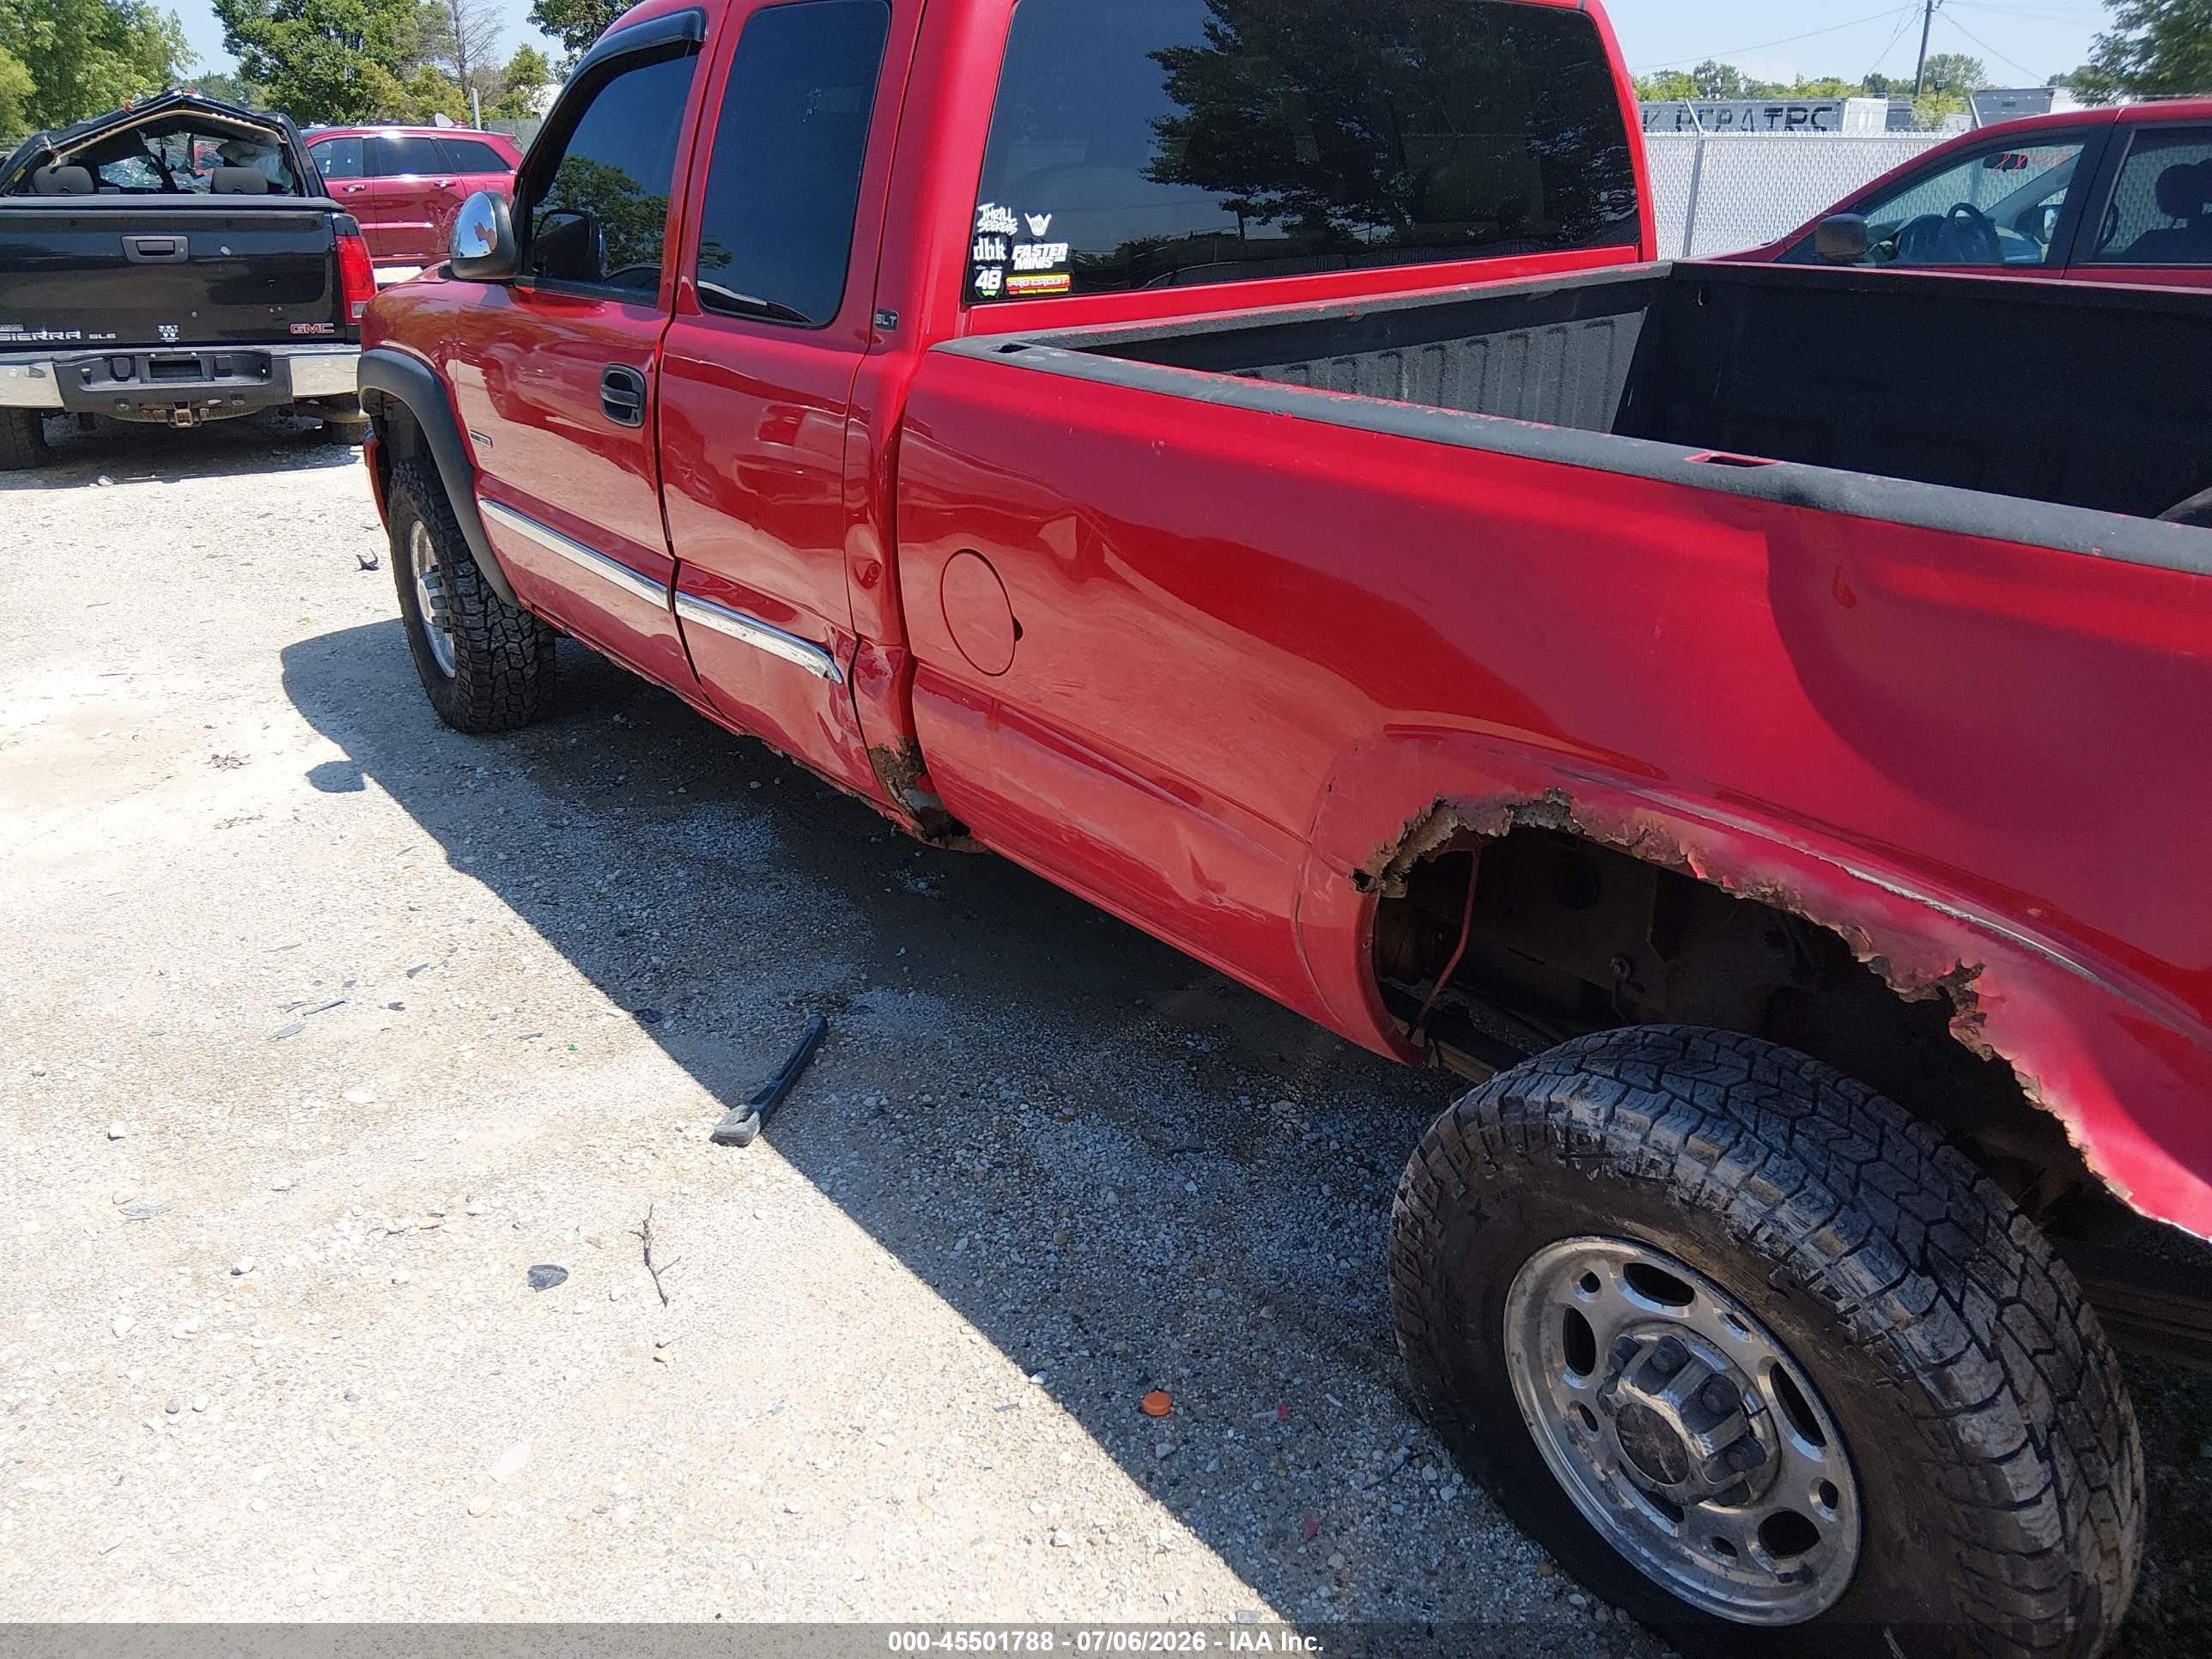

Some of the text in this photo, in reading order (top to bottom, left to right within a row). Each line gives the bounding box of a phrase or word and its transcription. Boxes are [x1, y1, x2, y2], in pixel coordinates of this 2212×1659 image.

[1012, 242, 1069, 260] FASTER
[1013, 257, 1054, 270] MINIS
[975, 270, 1002, 290] 48
[1008, 279, 1029, 288] PRO
[875, 313, 897, 326] SLT
[289, 323, 334, 333] GMC
